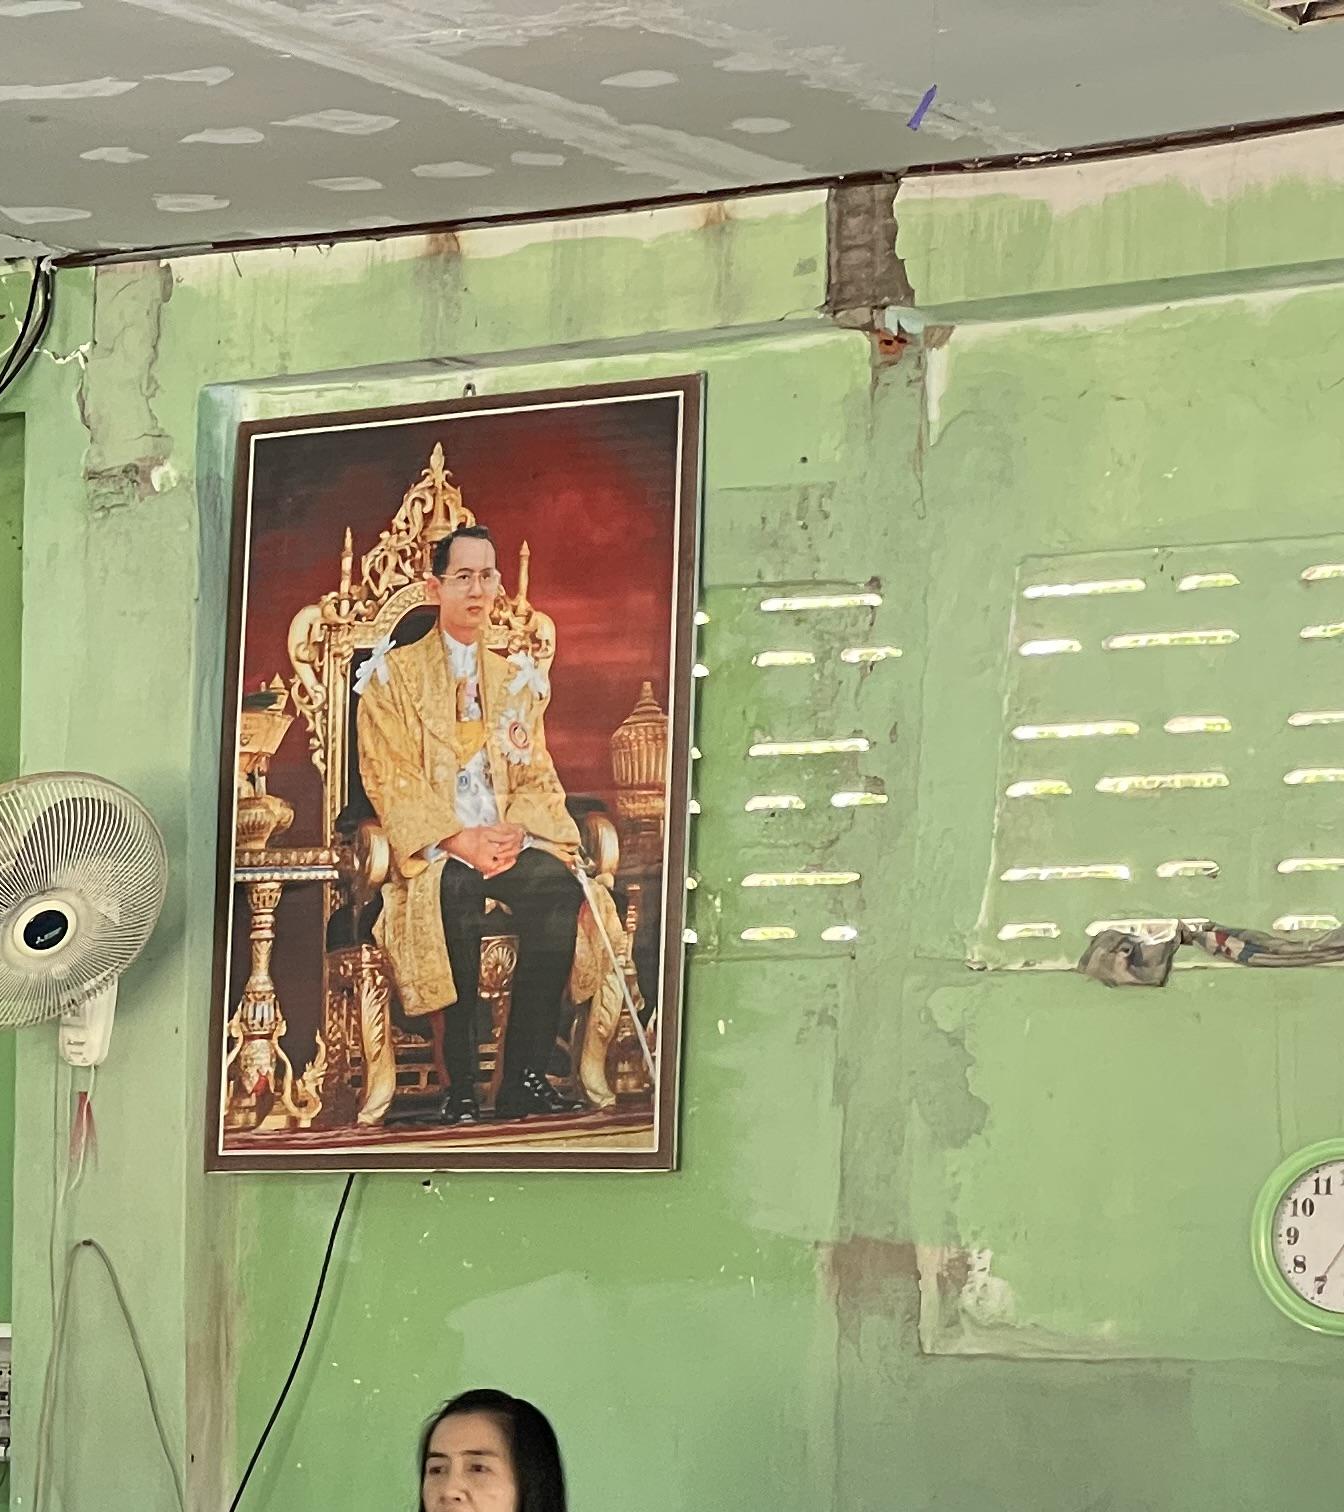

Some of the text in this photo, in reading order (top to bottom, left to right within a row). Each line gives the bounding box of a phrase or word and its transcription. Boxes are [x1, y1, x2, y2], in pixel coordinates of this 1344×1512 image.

[1313, 1176, 1332, 1195] 11
[1290, 1198, 1315, 1217] 10
[1286, 1226, 1300, 1246] 9
[1293, 1255, 1307, 1274] 8
[1313, 1275, 1328, 1295] 7
